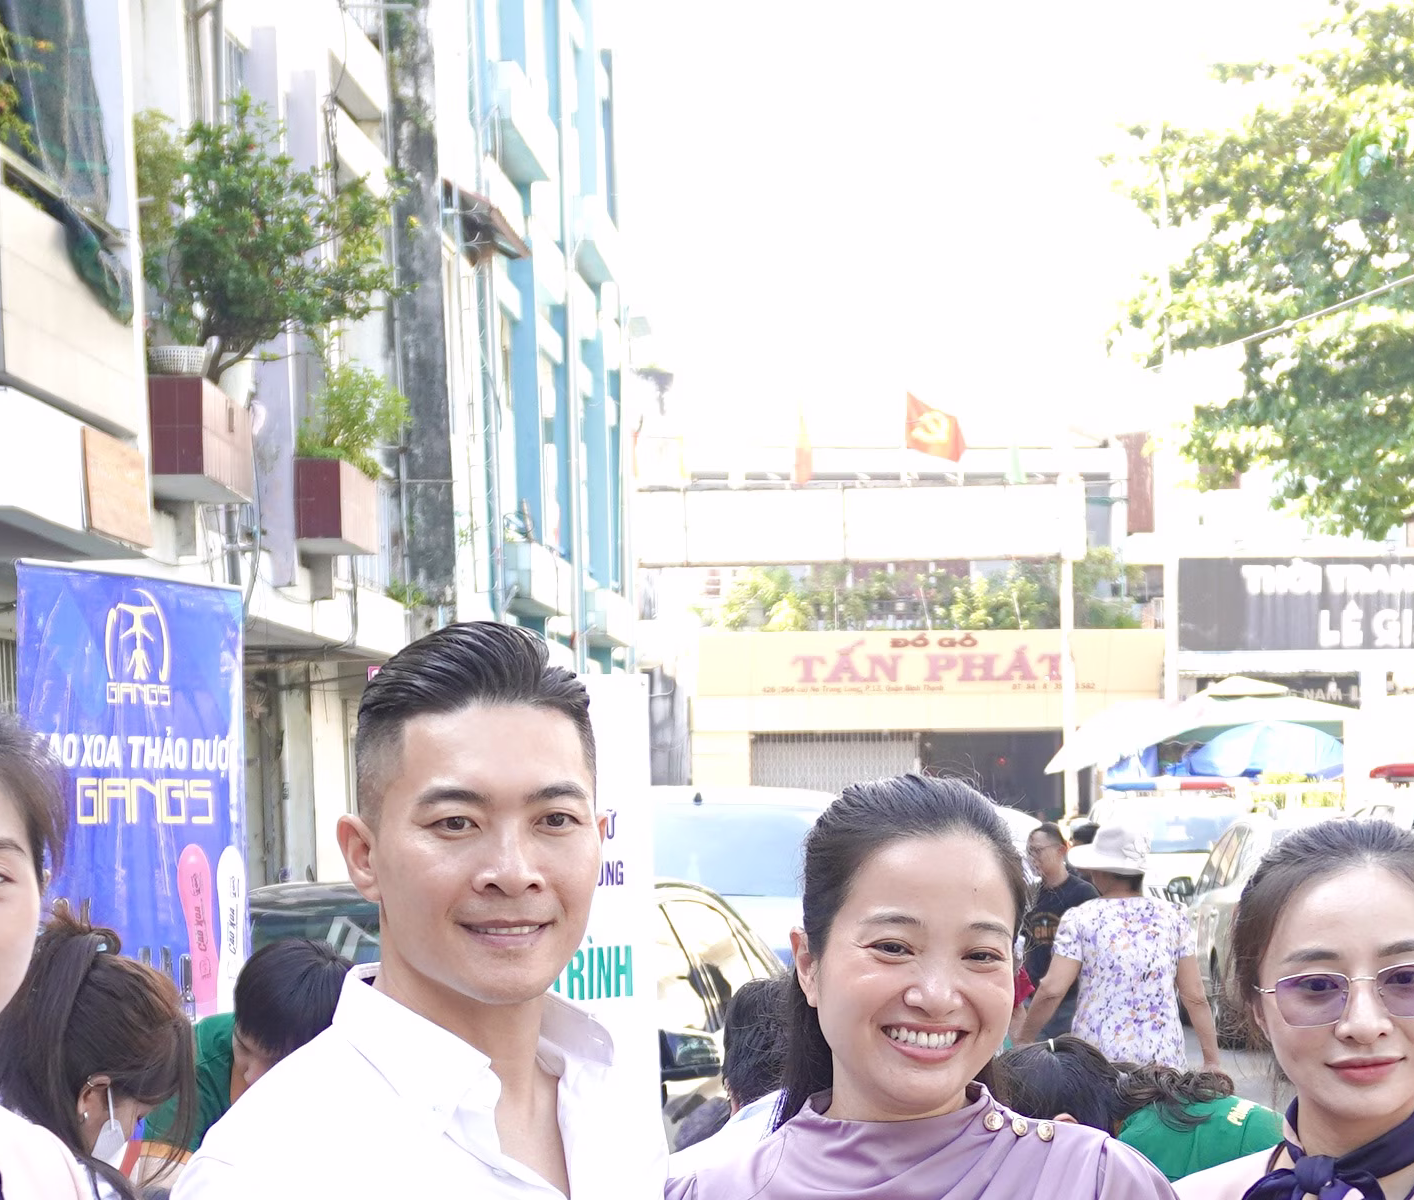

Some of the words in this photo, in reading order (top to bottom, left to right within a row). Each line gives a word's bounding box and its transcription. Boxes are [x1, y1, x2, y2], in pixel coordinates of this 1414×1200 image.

[1318, 600, 1364, 647] LÊ
[790, 639, 901, 683] TẤN
[80, 735, 122, 768] XOA
[127, 726, 189, 769] THẢO
